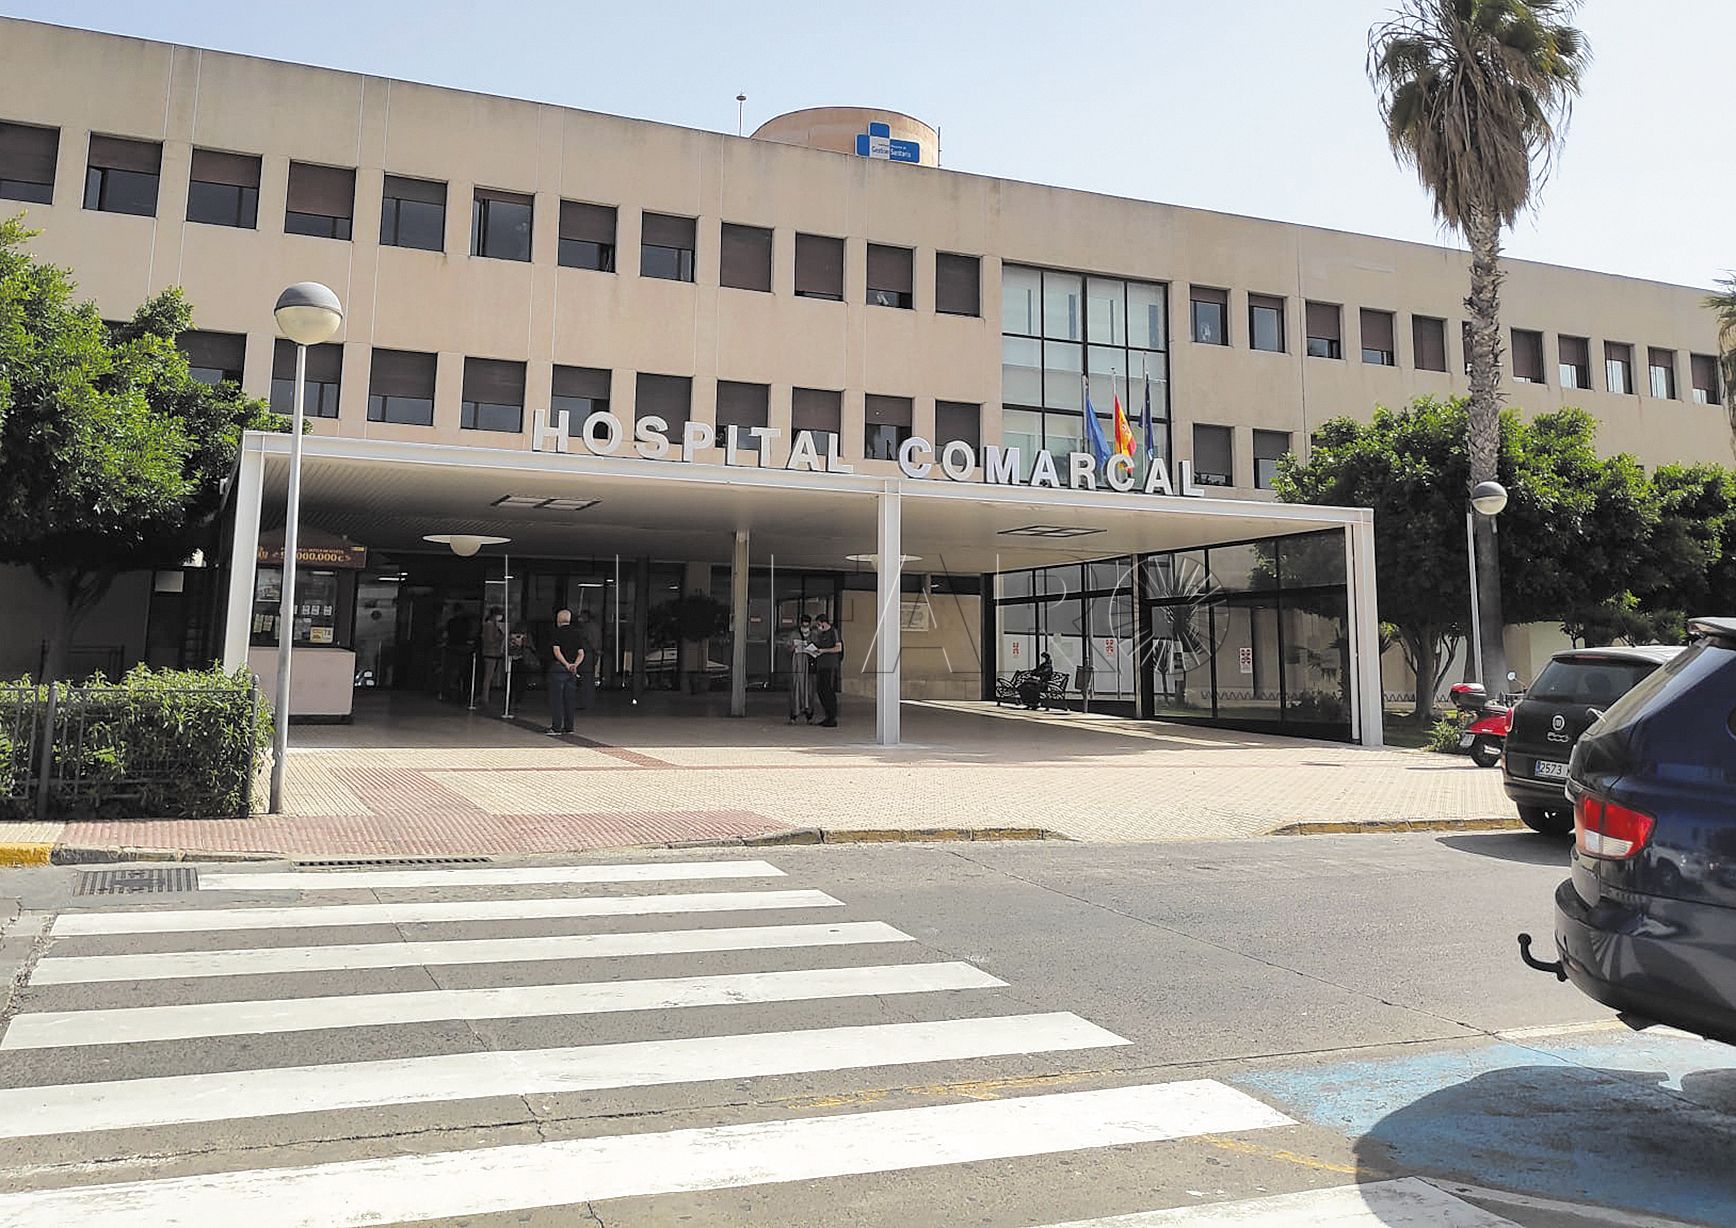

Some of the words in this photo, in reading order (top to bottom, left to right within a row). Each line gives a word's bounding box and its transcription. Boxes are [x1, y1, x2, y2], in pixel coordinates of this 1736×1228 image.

[532, 408, 855, 474] HOSPITAL
[898, 436, 1205, 497] COMARCAL
[1540, 762, 1562, 775] 2573
